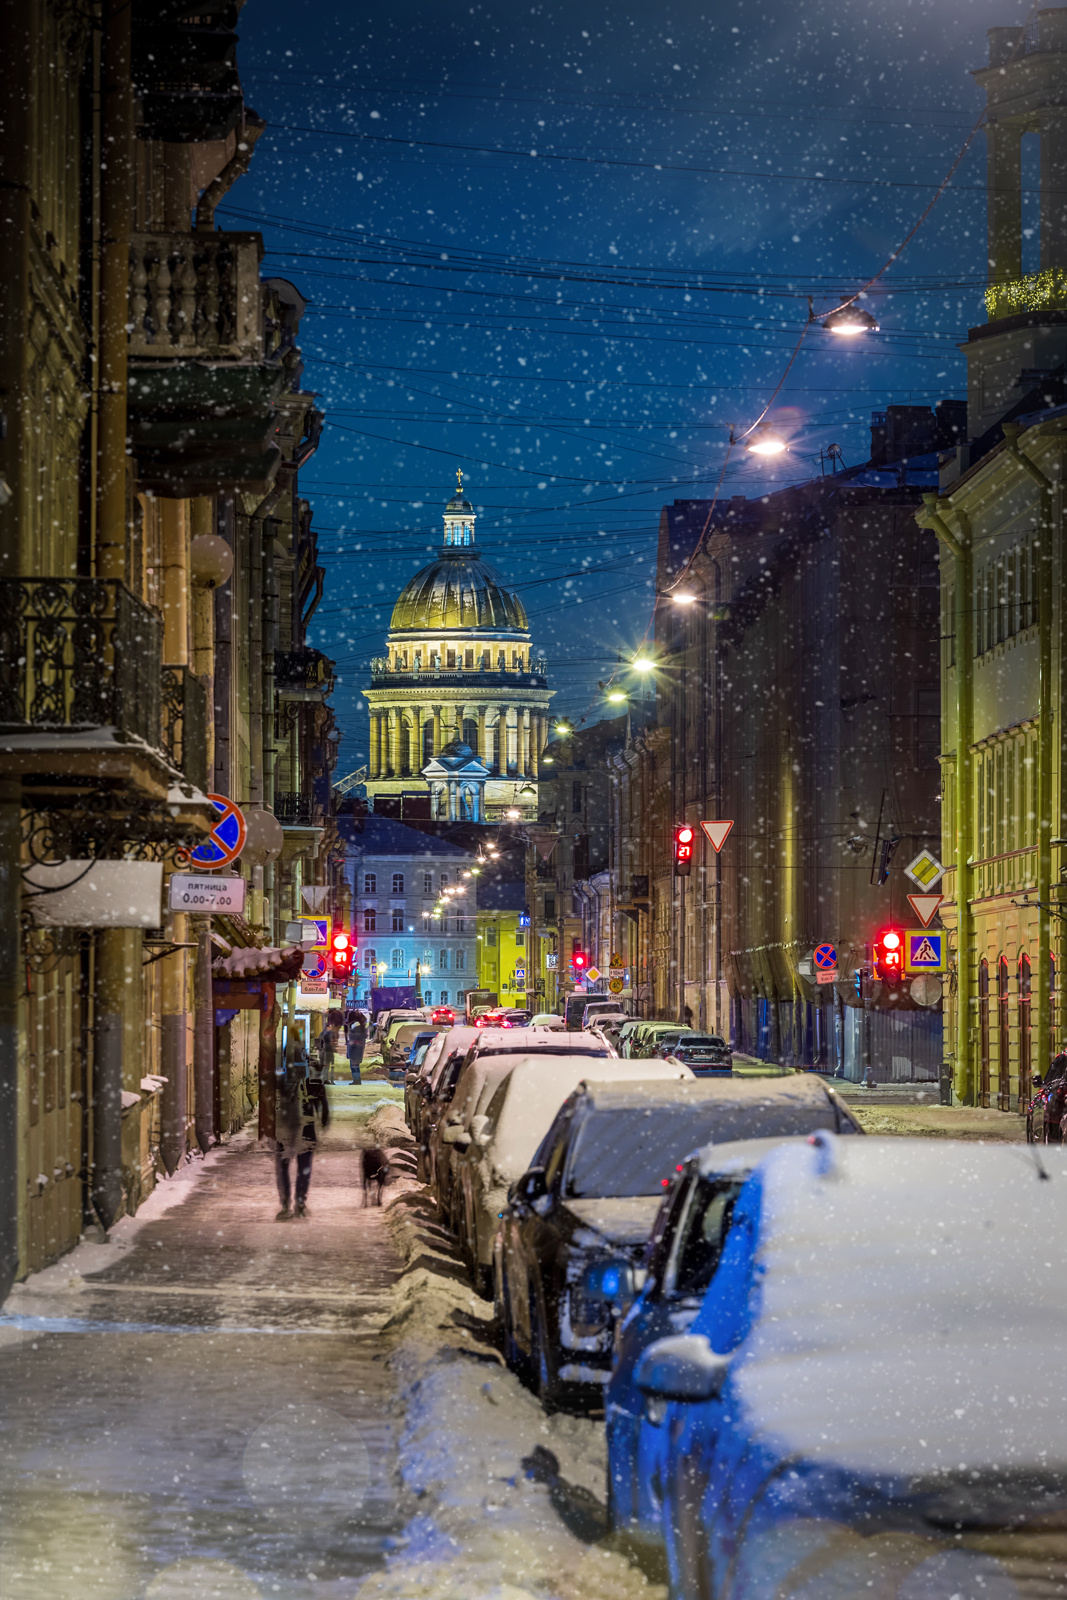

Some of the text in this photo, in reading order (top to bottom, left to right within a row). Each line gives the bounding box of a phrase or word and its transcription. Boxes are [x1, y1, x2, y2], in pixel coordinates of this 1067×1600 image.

[679, 846, 690, 857] 27
[187, 883, 228, 892] пятница
[182, 893, 232, 905] 0.00-7.00
